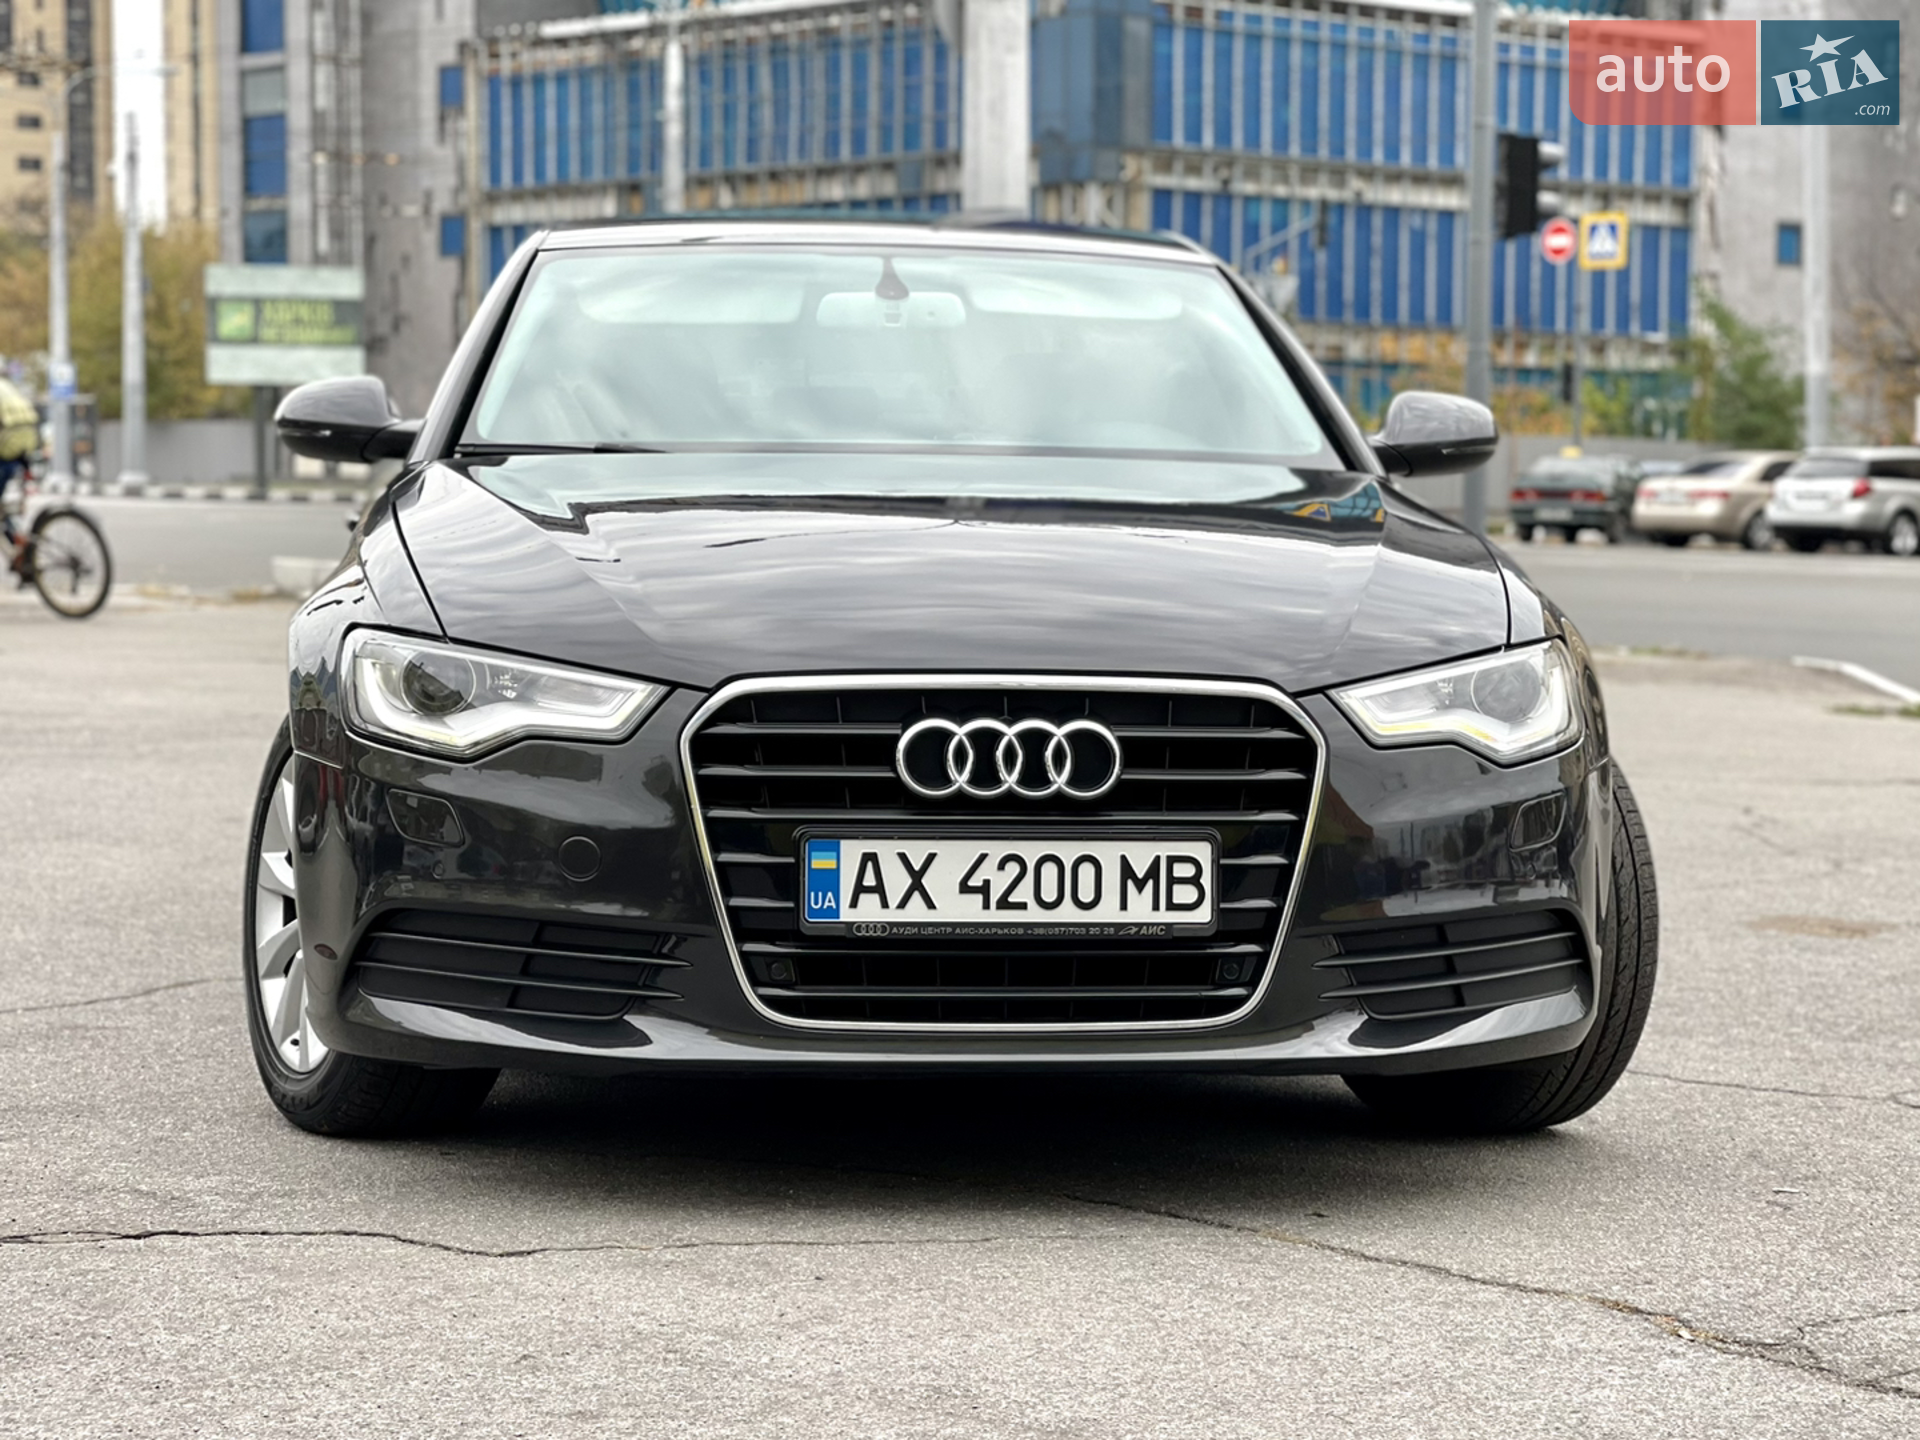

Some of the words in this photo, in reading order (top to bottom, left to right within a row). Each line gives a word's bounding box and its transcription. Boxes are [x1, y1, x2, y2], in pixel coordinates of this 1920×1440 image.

[848, 851, 938, 910] AX
[958, 851, 1103, 911] 4200
[1119, 853, 1207, 912] MB
[809, 891, 837, 910] UA
[891, 926, 919, 936] АУДИ
[920, 926, 953, 936] ЦЕНТР
[1139, 924, 1167, 936] АИС
